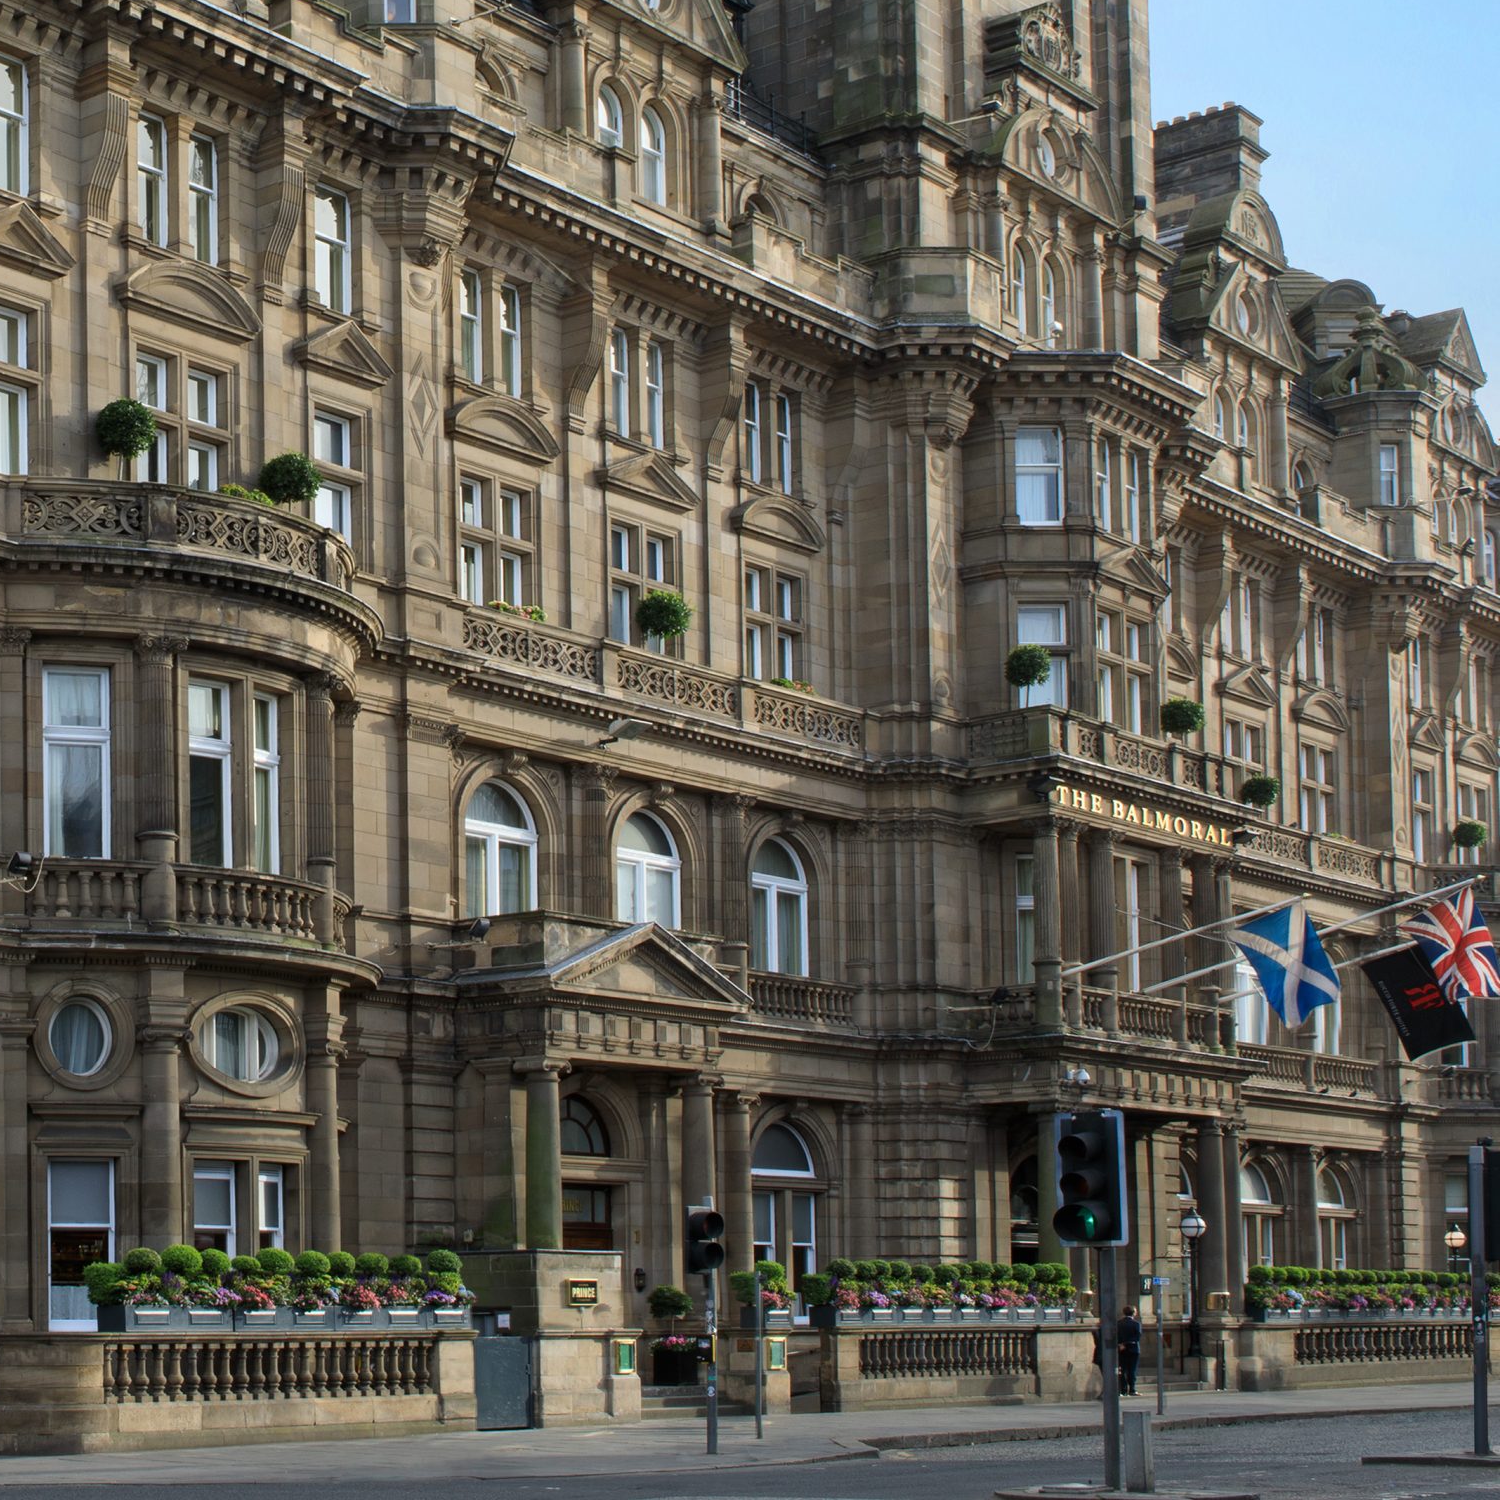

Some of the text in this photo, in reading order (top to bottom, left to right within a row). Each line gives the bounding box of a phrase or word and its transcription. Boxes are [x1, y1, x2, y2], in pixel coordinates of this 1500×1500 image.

[1056, 786, 1232, 847] THE BALMORAL
[572, 1287, 596, 1298] PRINCE
